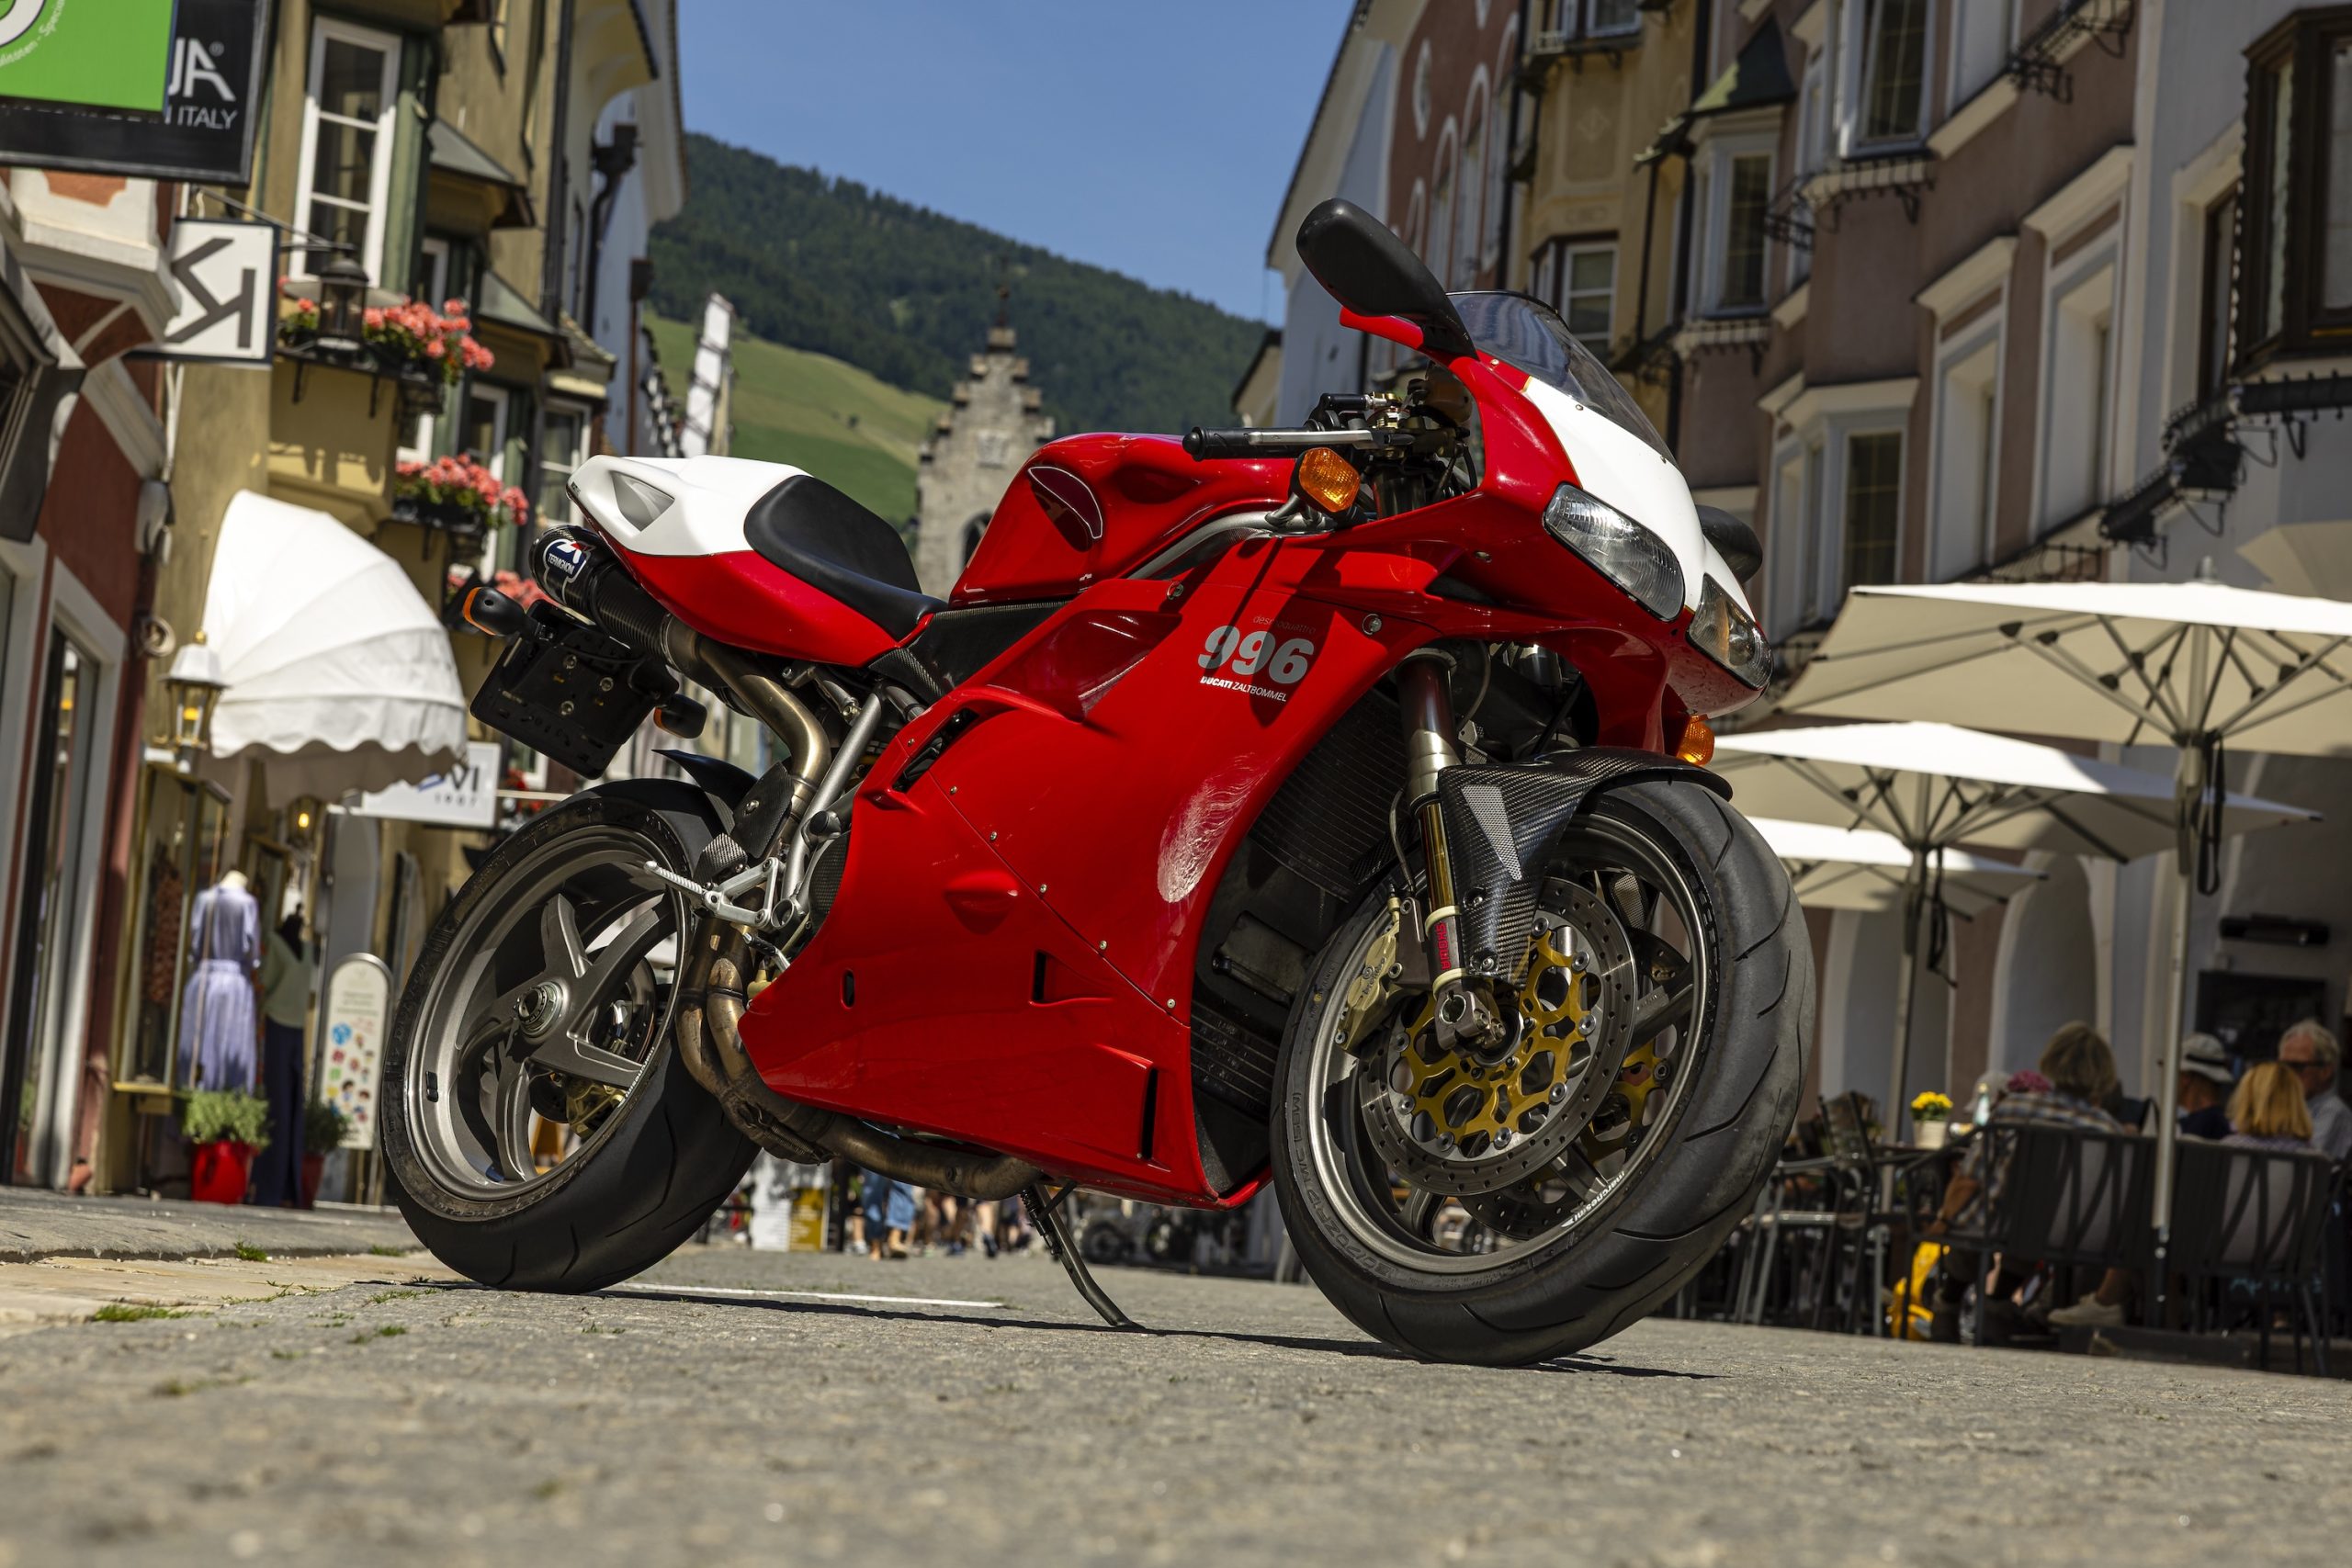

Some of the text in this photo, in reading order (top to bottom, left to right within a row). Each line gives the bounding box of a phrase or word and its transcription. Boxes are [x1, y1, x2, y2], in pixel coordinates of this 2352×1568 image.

[177, 106, 238, 130] ITALY
[1198, 626, 1315, 684] 996
[1199, 675, 1287, 702] DUCATI ZALTBOMMEL
[1435, 921, 1452, 971] SHOWA
